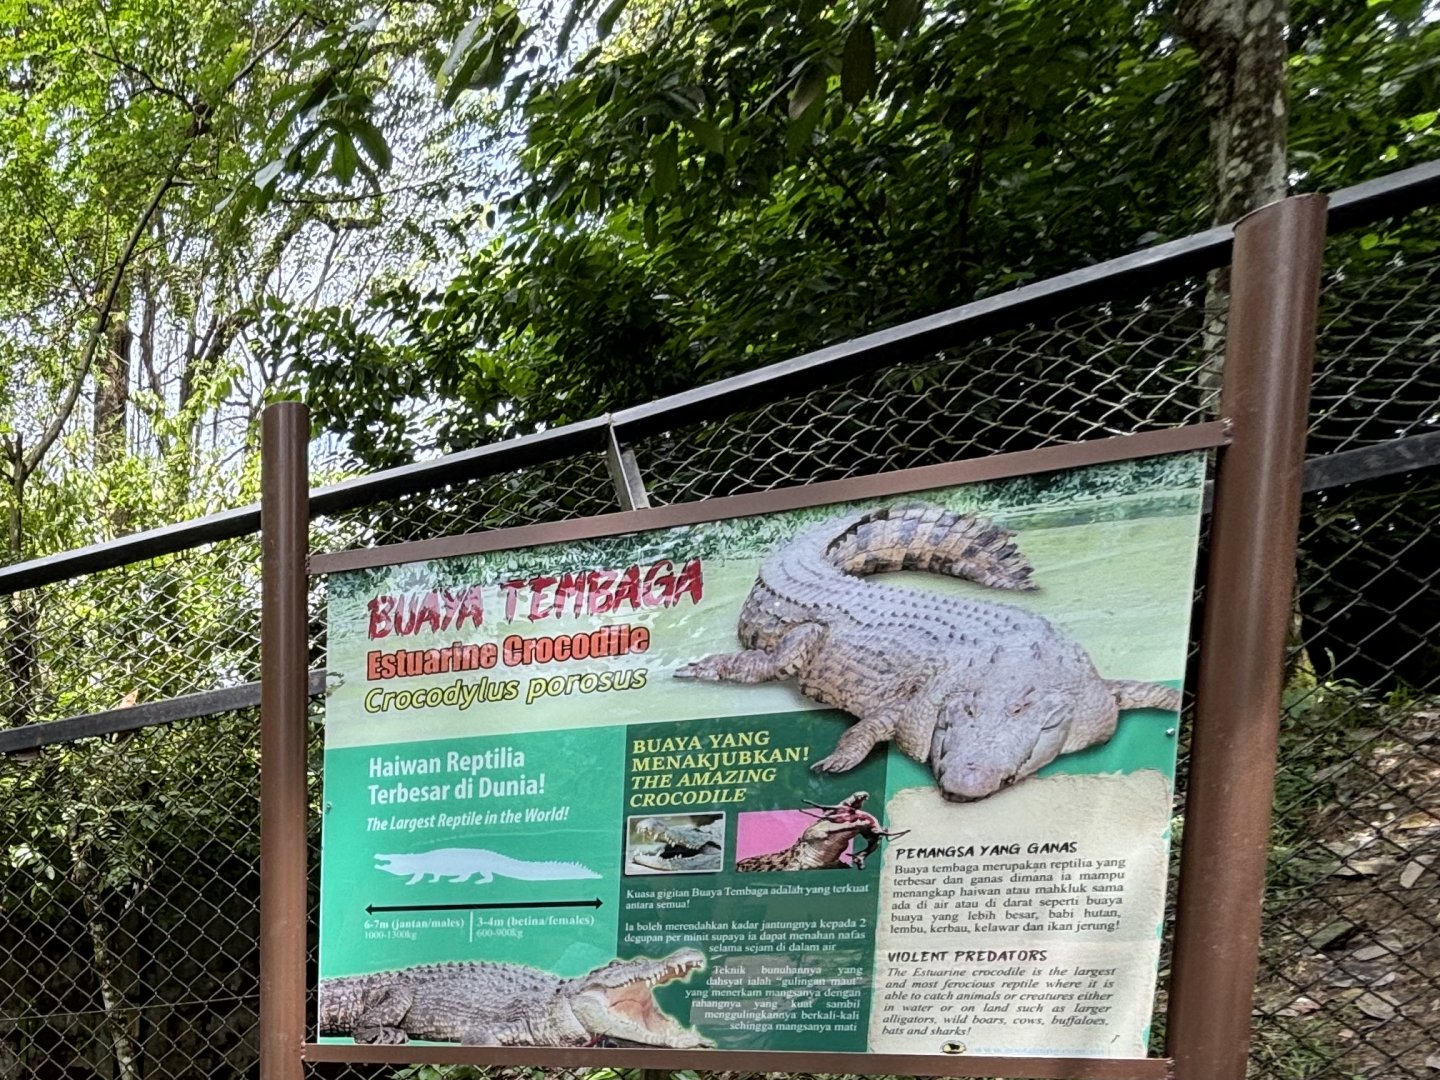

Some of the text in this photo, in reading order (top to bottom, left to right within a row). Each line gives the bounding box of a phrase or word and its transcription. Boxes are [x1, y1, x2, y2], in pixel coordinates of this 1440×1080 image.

[367, 557, 703, 640] BUAYA TEMBAGA
[367, 624, 650, 681] Estuarine Crocodile
[364, 667, 648, 713] Crocodylus porosus
[633, 731, 770, 754] BUAYA YANG
[369, 747, 525, 777] Haiwan Reptilia
[631, 747, 809, 772] MENAKJUBKAN!
[632, 768, 777, 790] THE AMAZING
[368, 773, 545, 805] Terbesar di Dunia!
[630, 788, 747, 807] CROCODILE
[367, 807, 569, 832] The Largest Reptile in the World!
[896, 842, 1078, 859] PEMANGSA YANG GANAS
[895, 858, 1126, 875] Buaya tembaga merupakan reptilia yang
[893, 872, 1125, 886] terbesar dan ganas dimana ia mampu
[626, 884, 869, 900] Kuasa gigitan Buaya Tembaga adalah yang terkuat
[893, 884, 1124, 899] menangkap haiwan atau mahkluk sama
[626, 899, 690, 909] antara semua!
[891, 895, 1123, 910] ada di air atau di darat seperti buaya
[477, 915, 595, 926] 3-4m (betina/females)
[891, 908, 1121, 923] buaya yang lebih besar, babi hutan,
[364, 918, 465, 930] 6-7m (jantan/males)
[626, 918, 866, 931] Ia boleh merendahkan kadar jantungnya kepada 2
[890, 921, 1120, 934] lembu, kerbau, kelawar dan ikan jerung!
[476, 928, 523, 938] 600-900kg
[625, 930, 866, 943] degupan per minit supaya ia dapat menahan nafas
[709, 942, 836, 953] selama sejam di dalam air
[888, 950, 1048, 963] VIOLENT PREDATORS
[713, 965, 863, 976] Teknik bunuhannya yang
[887, 967, 1116, 977] The Estuarine crocodile is the largest
[706, 977, 863, 987] dahsyat ialah “gulingan maut”
[885, 979, 1114, 990] and most ferocious reptile where it is
[685, 988, 861, 998] yang menerkam mangsanya dengan
[884, 992, 908, 1000] able
[924, 991, 953, 1000] catch
[956, 991, 1000, 1000] animals
[1019, 992, 1074, 1000] creatures
[1077, 992, 1114, 1001] either
[691, 999, 860, 1010] rahangnya yang kuat sambil
[883, 1003, 894, 1012] in
[902, 1004, 934, 1012] water
[983, 1003, 1010, 1012] land
[1016, 1004, 1044, 1012] such
[1052, 1005, 1064, 1013] as
[1073, 1004, 1112, 1015] larger
[704, 1010, 859, 1021] menggulingkannya berkali-kali
[882, 1015, 1109, 1027] alligators, wild boars, cows, buffaloes,
[730, 1022, 857, 1033] sehingga mangsanya mati
[882, 1026, 972, 1035] bats and sharks!
